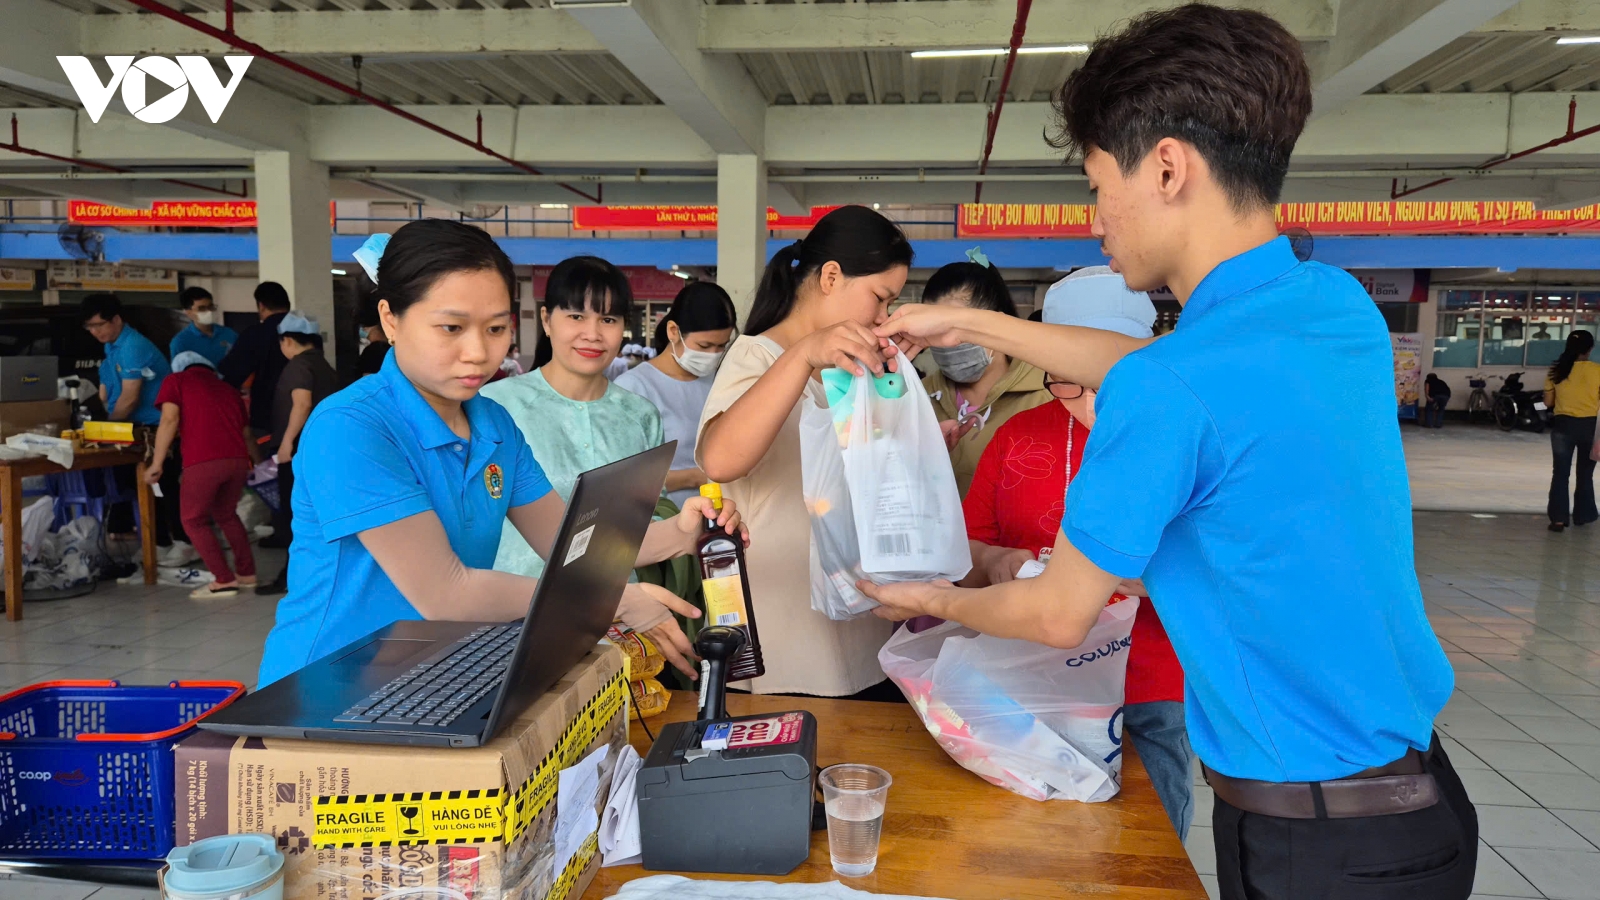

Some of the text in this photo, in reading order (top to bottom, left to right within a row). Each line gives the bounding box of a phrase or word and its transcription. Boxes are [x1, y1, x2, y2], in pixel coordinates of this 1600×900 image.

[76, 205, 86, 216] LÀ
[158, 204, 169, 217] XÃ
[673, 212, 689, 222] THỨ
[698, 213, 718, 223] NHIỆ
[1061, 204, 1087, 225] DUNG
[19, 771, 52, 781] co.op
[187, 766, 197, 775] kg
[245, 764, 253, 778] Hạn
[255, 765, 264, 781] Ngày
[188, 776, 197, 788] (14
[529, 766, 556, 804] FRAGILE
[198, 760, 208, 819] Khối lượng tịnh:
[245, 788, 254, 805] dụng
[187, 790, 197, 805] bịch
[256, 795, 264, 810] xuất
[189, 812, 196, 822] 20
[245, 806, 254, 826] (HSD):
[269, 807, 273, 816] BH
[316, 804, 505, 825] FRAGILE HÀNG DỄ V
[187, 823, 197, 834] gói
[256, 812, 264, 832] (NSX):
[479, 822, 497, 830] NHẸ
